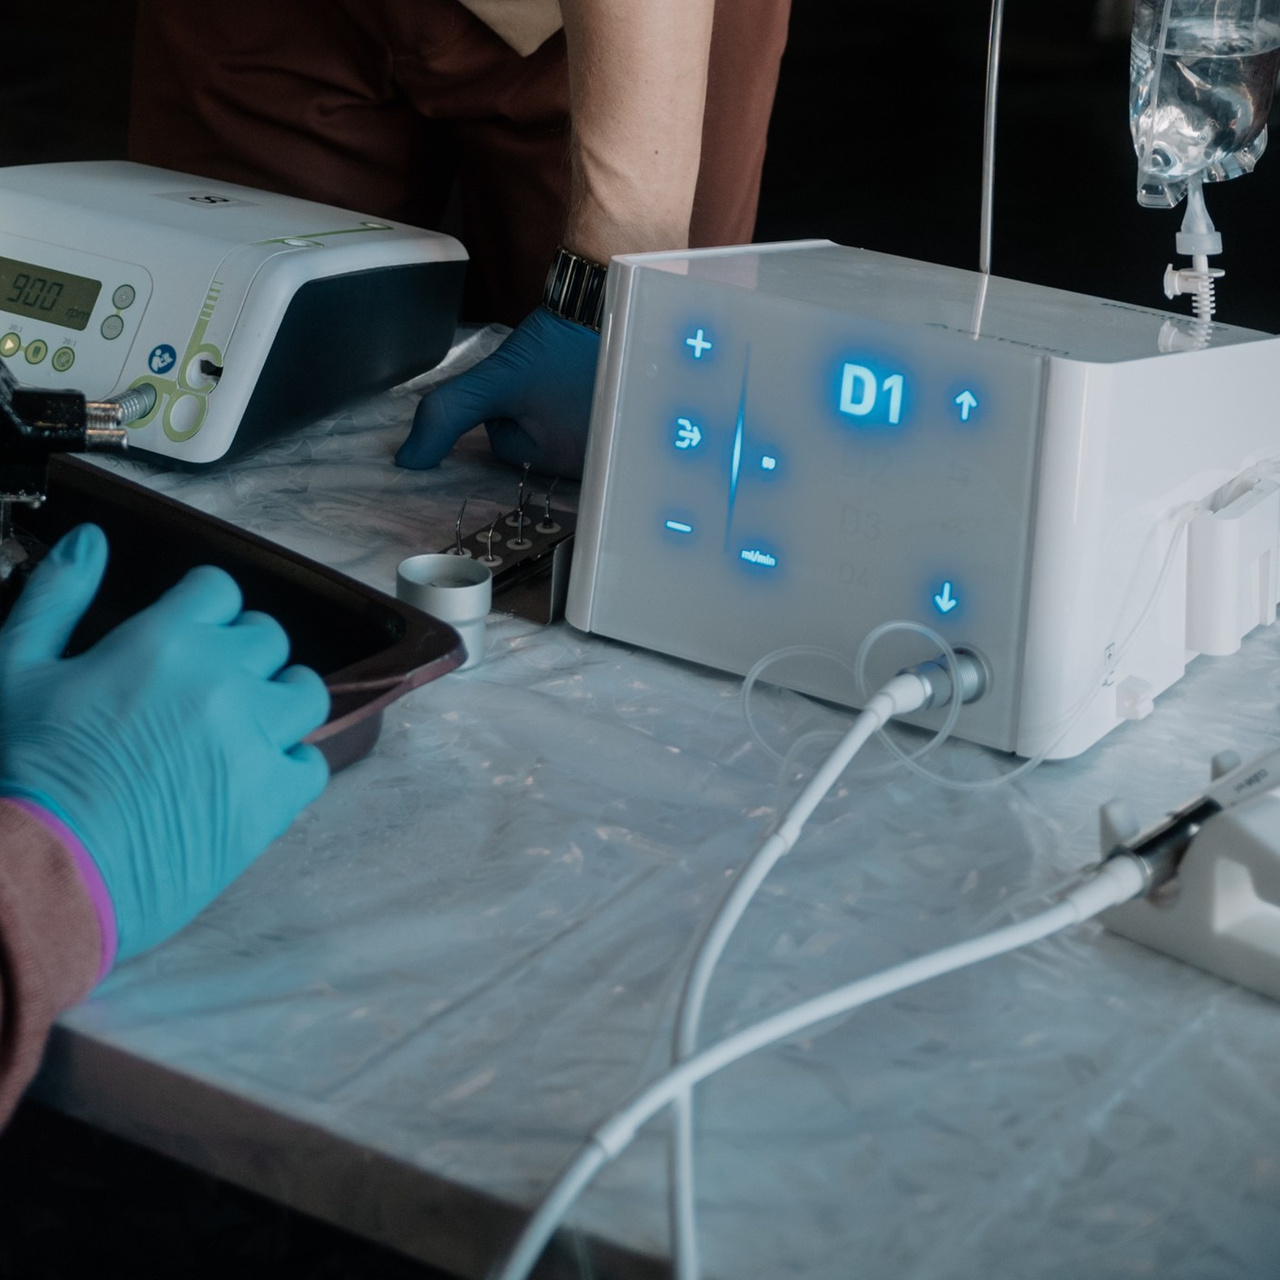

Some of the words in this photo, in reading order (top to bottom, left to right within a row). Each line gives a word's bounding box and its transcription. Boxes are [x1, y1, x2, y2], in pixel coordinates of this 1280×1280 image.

[6, 273, 64, 311] 900
[65, 306, 91, 321] rpm
[839, 362, 904, 425] D1
